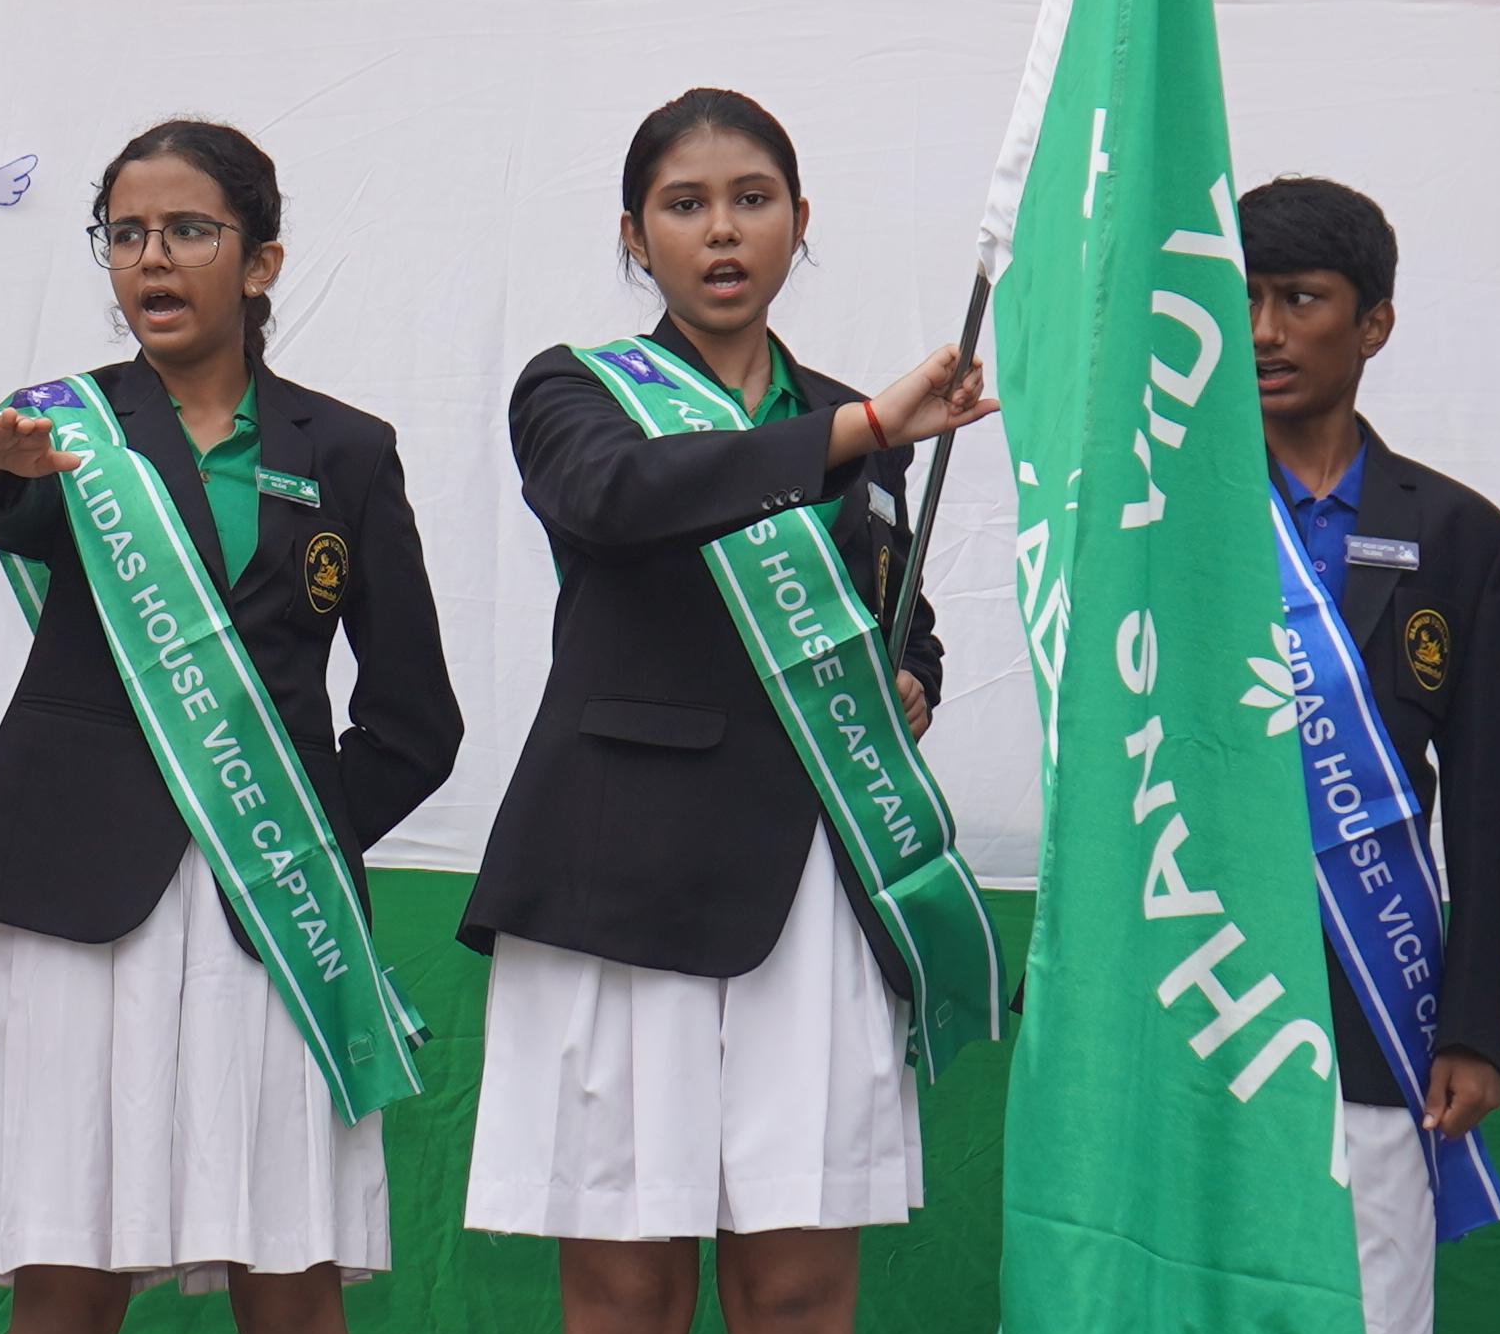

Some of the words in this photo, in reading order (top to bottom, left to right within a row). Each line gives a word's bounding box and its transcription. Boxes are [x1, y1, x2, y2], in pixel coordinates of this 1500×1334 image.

[57, 421, 146, 591] KALIDAS
[132, 582, 219, 722] HOUSE
[202, 719, 265, 816] VICE
[250, 818, 350, 984] CAPTAIN
[761, 554, 845, 687] HOUSE
[828, 692, 922, 859] CAPTAIN
[1314, 752, 1393, 895] HOUSE
[1378, 894, 1430, 991] VICE
